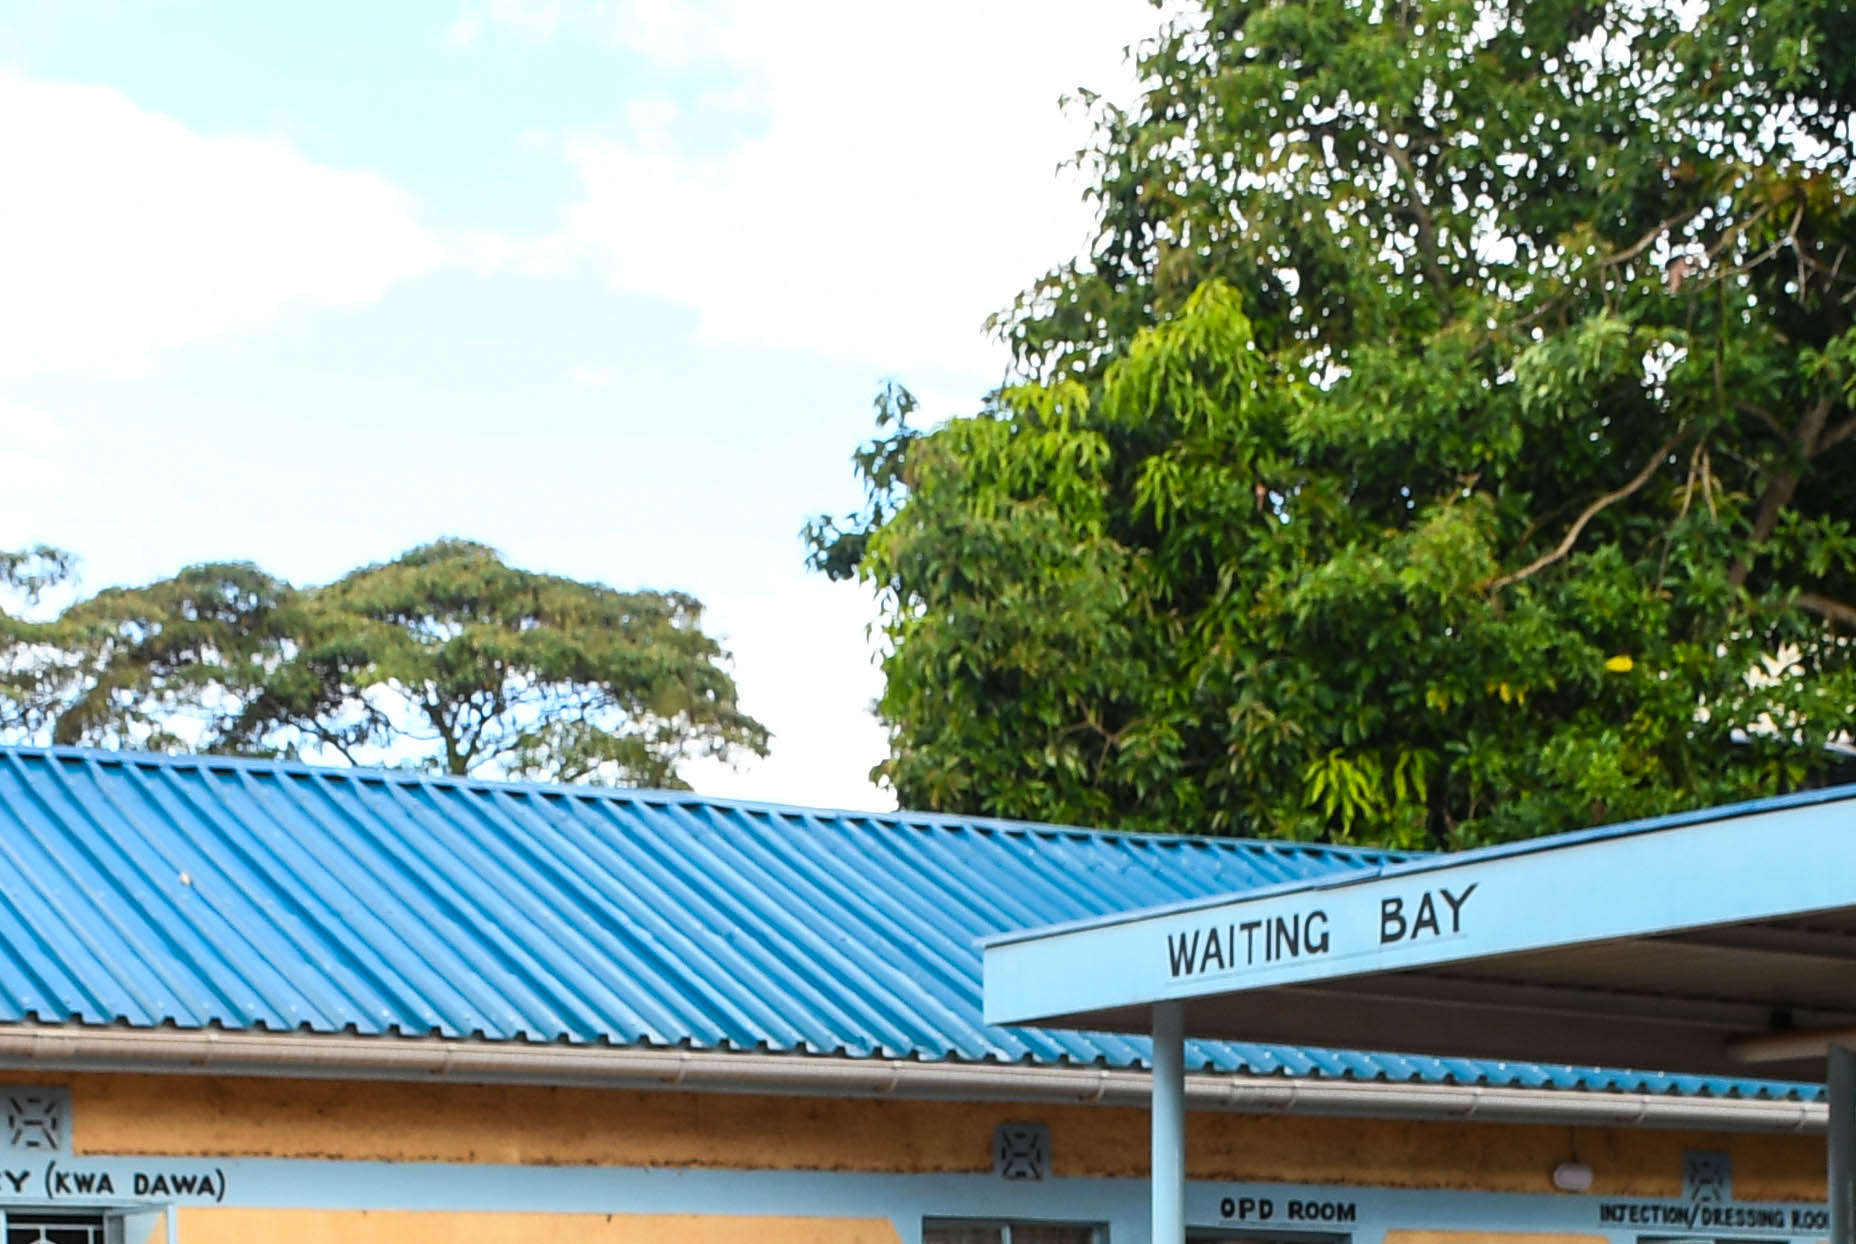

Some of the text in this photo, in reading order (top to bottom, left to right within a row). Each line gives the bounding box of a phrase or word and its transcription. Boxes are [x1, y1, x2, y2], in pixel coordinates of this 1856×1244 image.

[1167, 882, 1479, 977] WAITING BAY
[45, 1160, 115, 1199] (KWA
[134, 1168, 226, 1203] DAWA)
[1220, 1197, 1357, 1222] OPD ROOM
[1792, 1208, 1831, 1230] ROO
